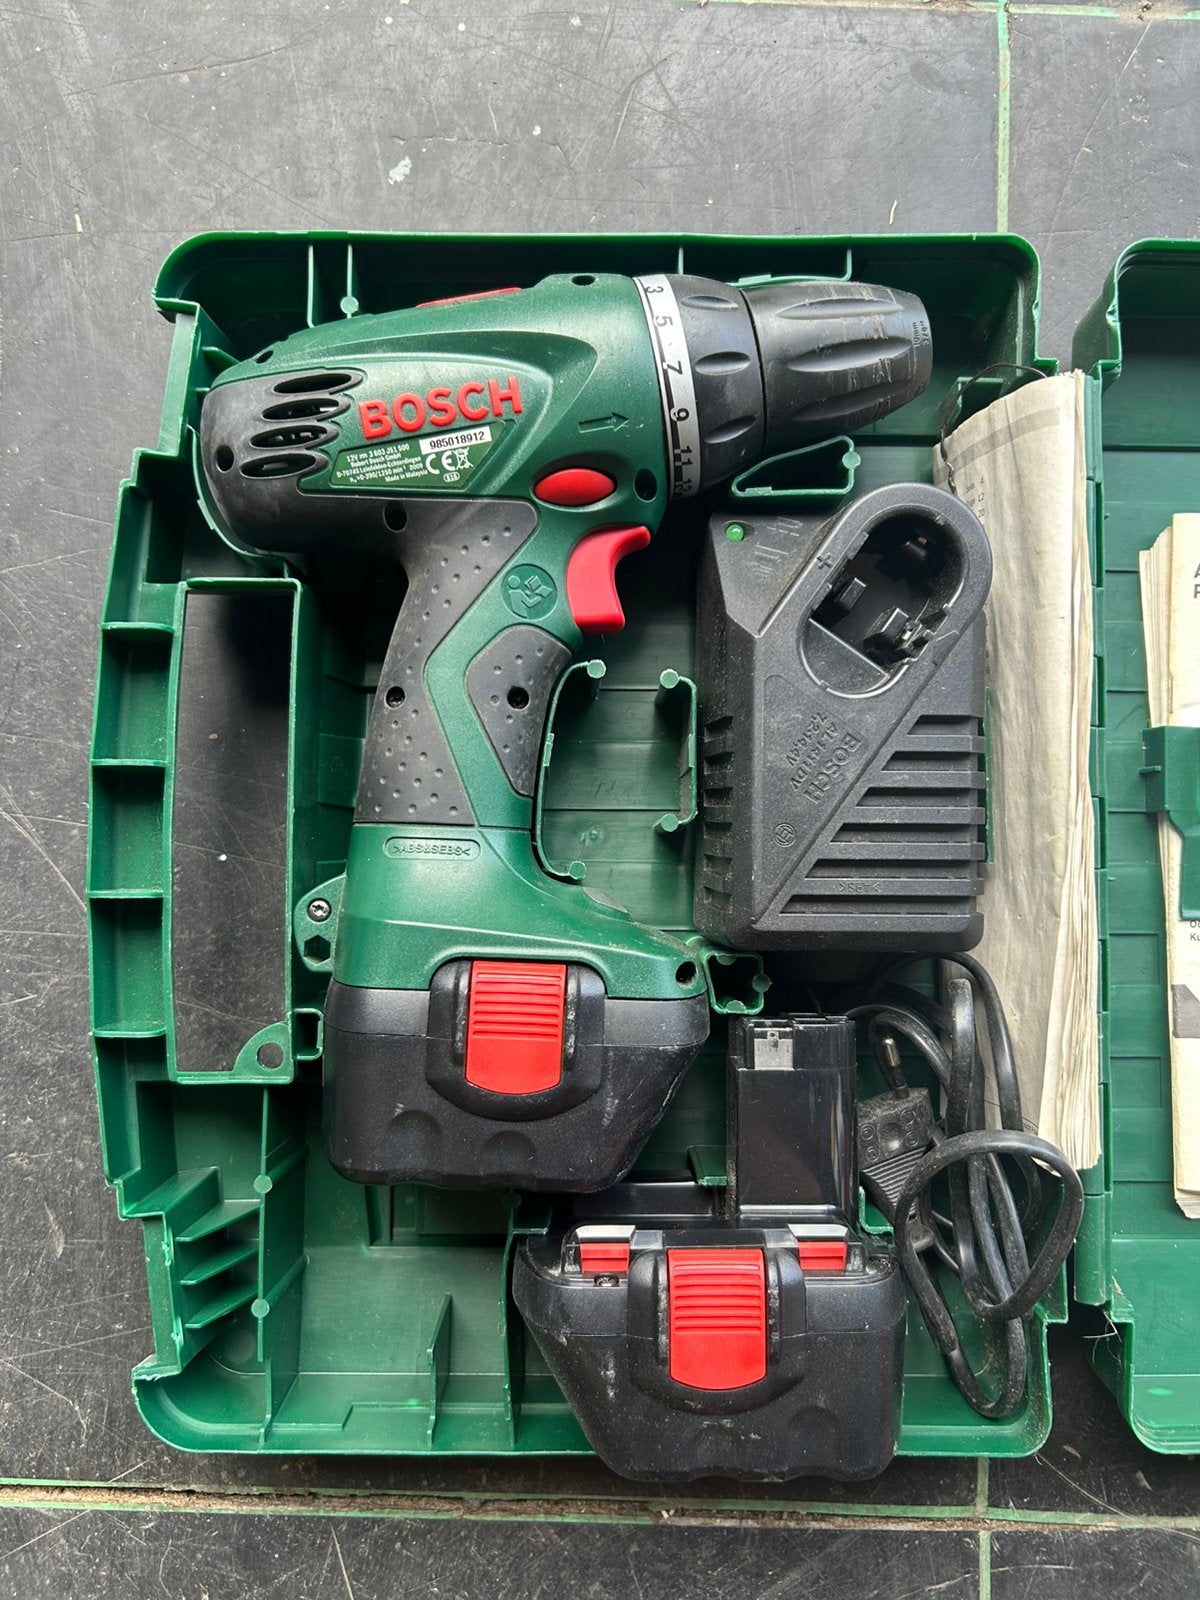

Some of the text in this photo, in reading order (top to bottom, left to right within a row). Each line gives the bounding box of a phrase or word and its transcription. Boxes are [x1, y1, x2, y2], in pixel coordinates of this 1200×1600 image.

[654, 316, 674, 327] 5
[663, 360, 683, 375] 7
[358, 375, 523, 440] BOSCH
[670, 408, 689, 422] 9
[429, 430, 485, 449] 985018912
[674, 446, 692, 466] 11
[802, 732, 862, 804] BOSCH
